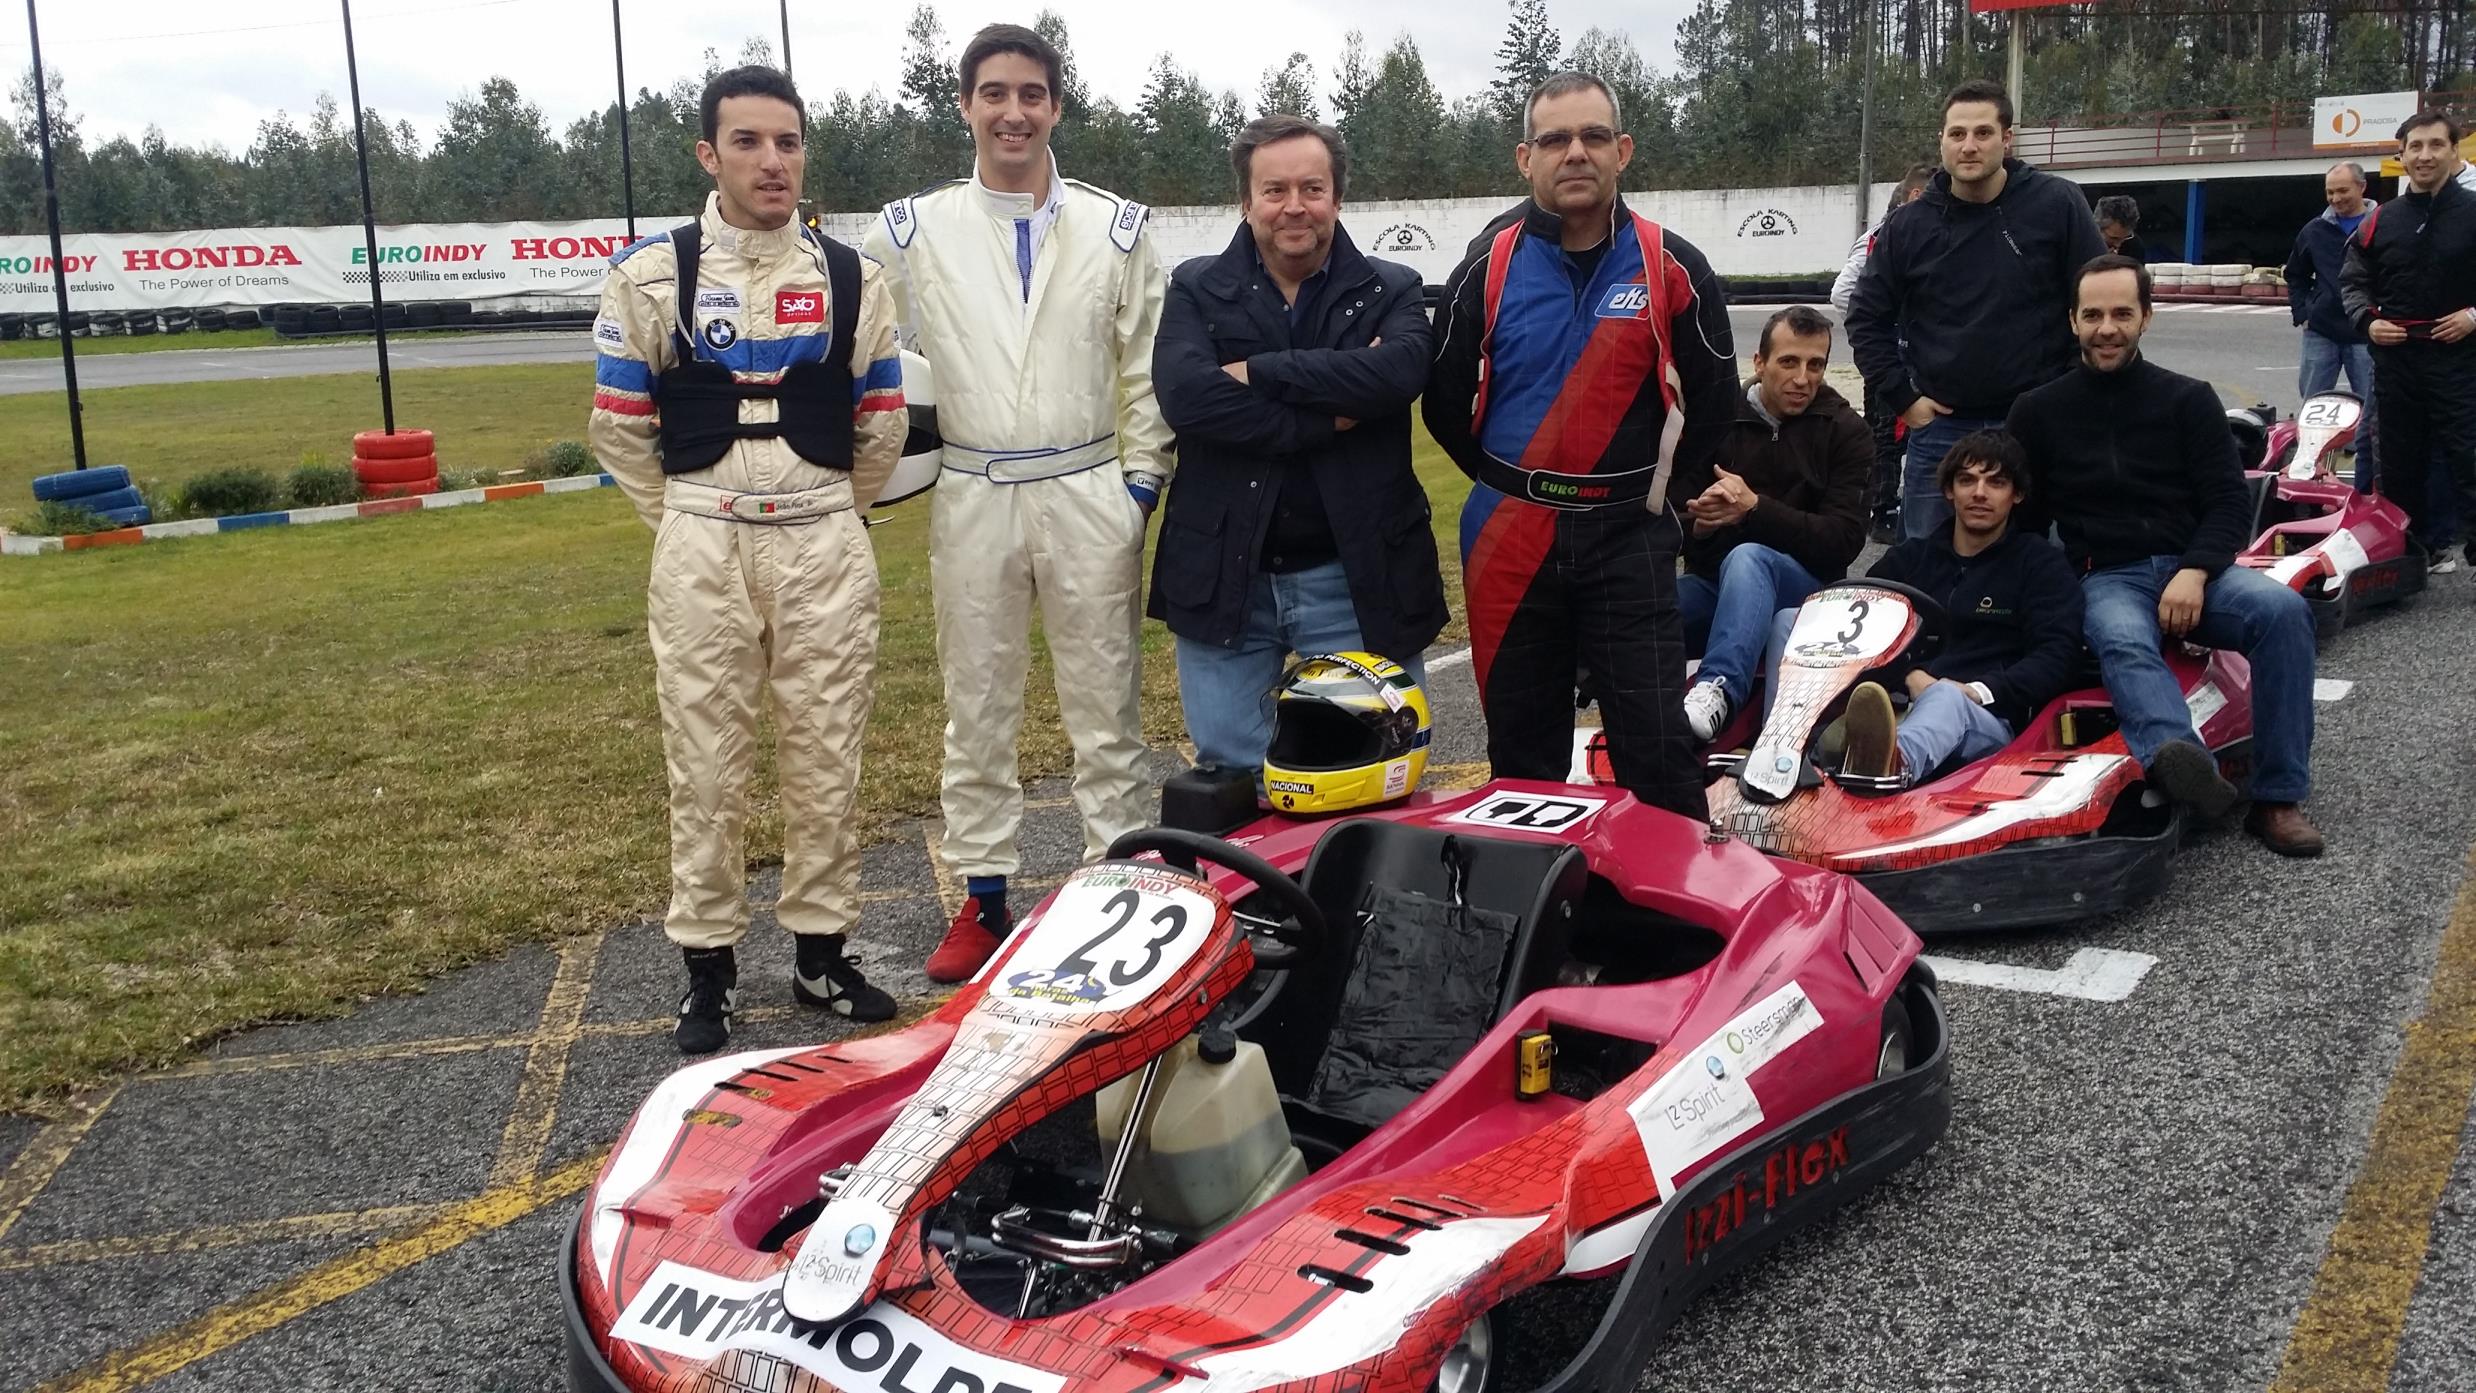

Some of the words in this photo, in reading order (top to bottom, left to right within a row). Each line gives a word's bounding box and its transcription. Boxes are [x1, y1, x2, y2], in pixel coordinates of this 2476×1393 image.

[1737, 209, 1764, 237] ESCOLA
[1768, 208, 1798, 235] KARTING
[1373, 224, 1400, 251] ESCOLA
[1405, 223, 1436, 250] KARTING
[122, 245, 302, 271] HONDA
[511, 236, 645, 260] HON
[139, 279, 165, 291] The
[170, 278, 213, 290] Power
[218, 276, 231, 287] of
[236, 275, 289, 287] Dreams
[408, 270, 440, 282] Utiliza
[444, 273, 459, 281] em
[462, 269, 506, 281] exclusivo
[530, 267, 556, 279] The
[560, 266, 603, 278] Power
[15, 282, 48, 294] Utiliza
[70, 280, 115, 292] exclusivo
[2305, 404, 2341, 422] 24
[1540, 481, 1611, 497] EUROINDY
[1838, 601, 1869, 647] 3
[1325, 654, 1380, 685] PERFECTION
[1270, 781, 1312, 794] NACIONAL
[1082, 874, 1180, 895] EUROINDY
[1055, 889, 1188, 987] 23
